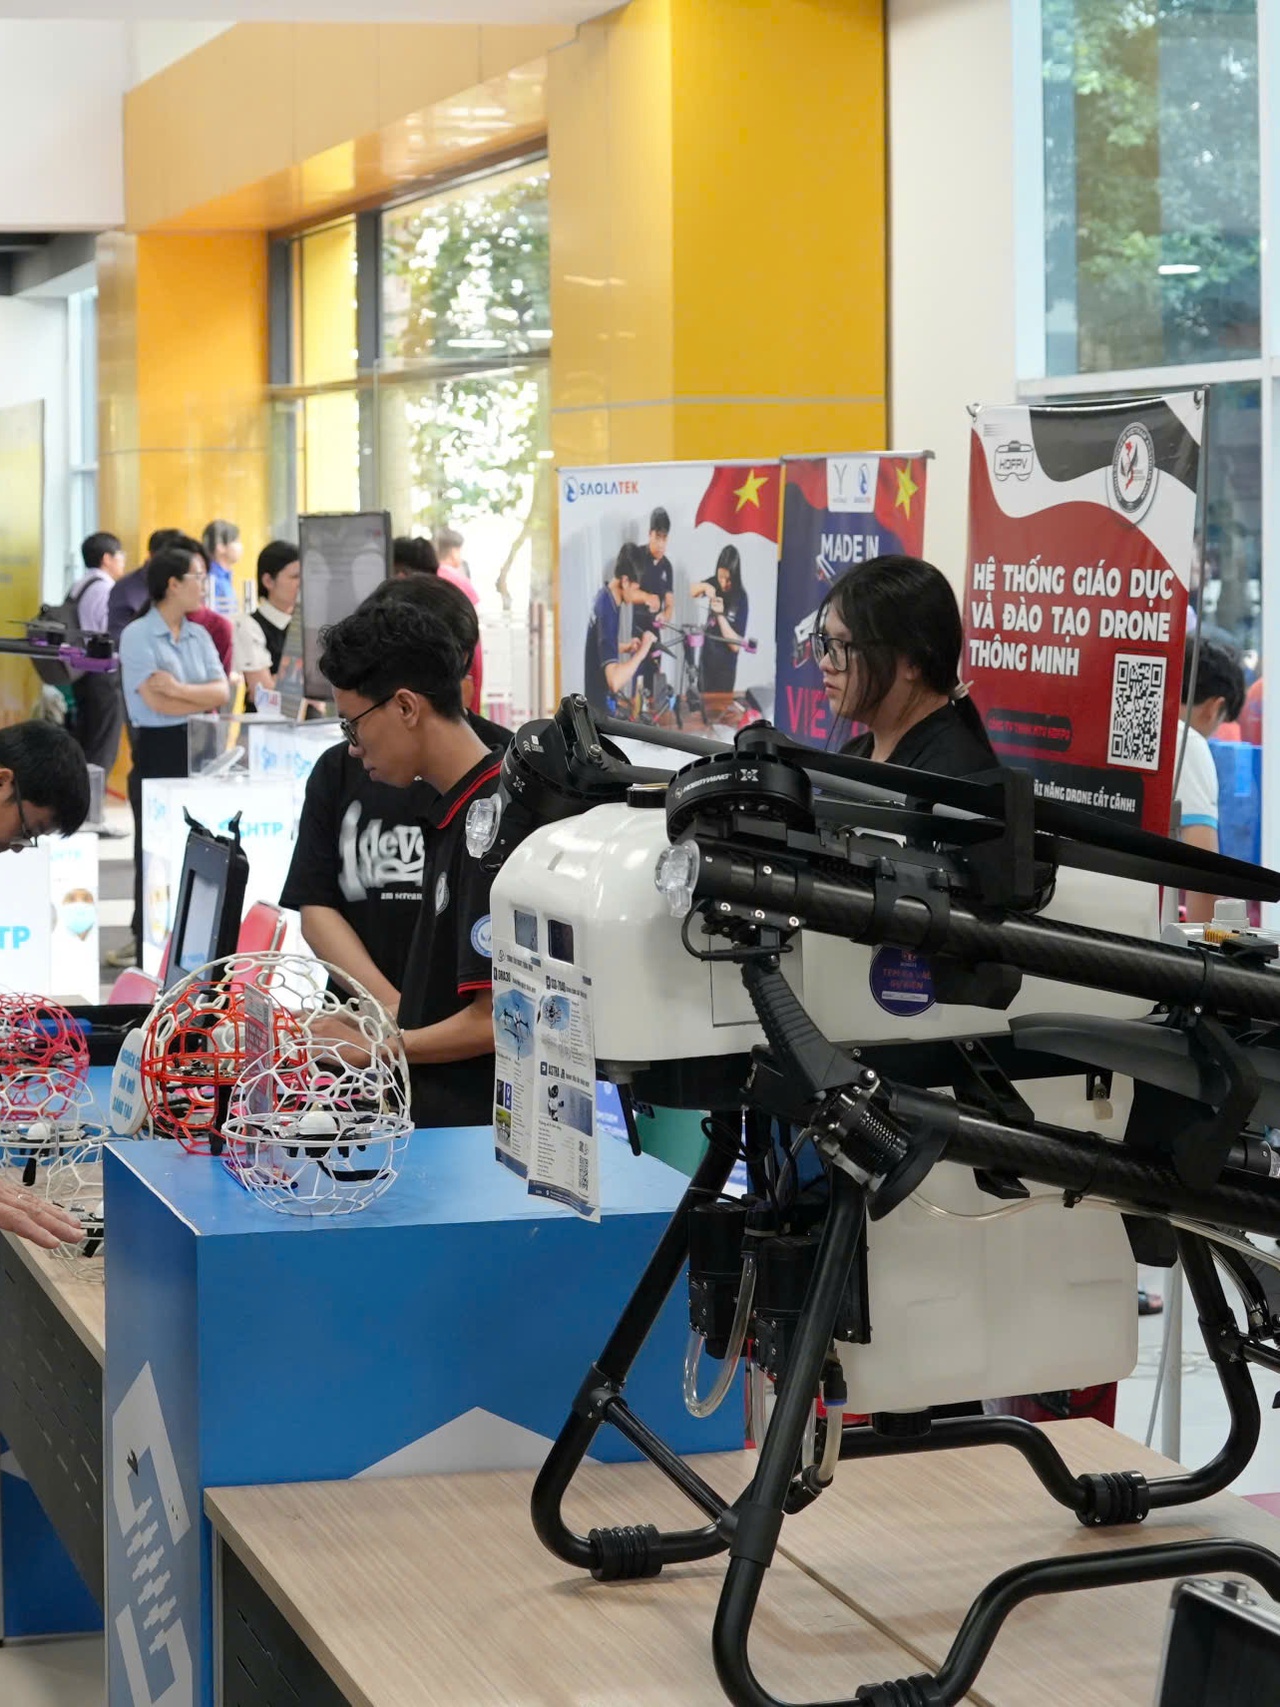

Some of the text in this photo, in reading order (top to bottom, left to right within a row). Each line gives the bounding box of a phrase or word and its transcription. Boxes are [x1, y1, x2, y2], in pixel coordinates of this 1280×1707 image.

[580, 480, 639, 496] SAOLATEK
[821, 533, 879, 563] MADE IN
[1003, 554, 1065, 595] THỐNG
[1073, 559, 1122, 597] GIÁO
[1129, 569, 1174, 608] DỤC
[1002, 596, 1043, 633] ĐÀO
[1051, 606, 1091, 644] TẠO
[1099, 609, 1170, 642] DRONE
[970, 633, 1080, 677] THÔNG MINH
[1065, 787, 1092, 806] DRONE
